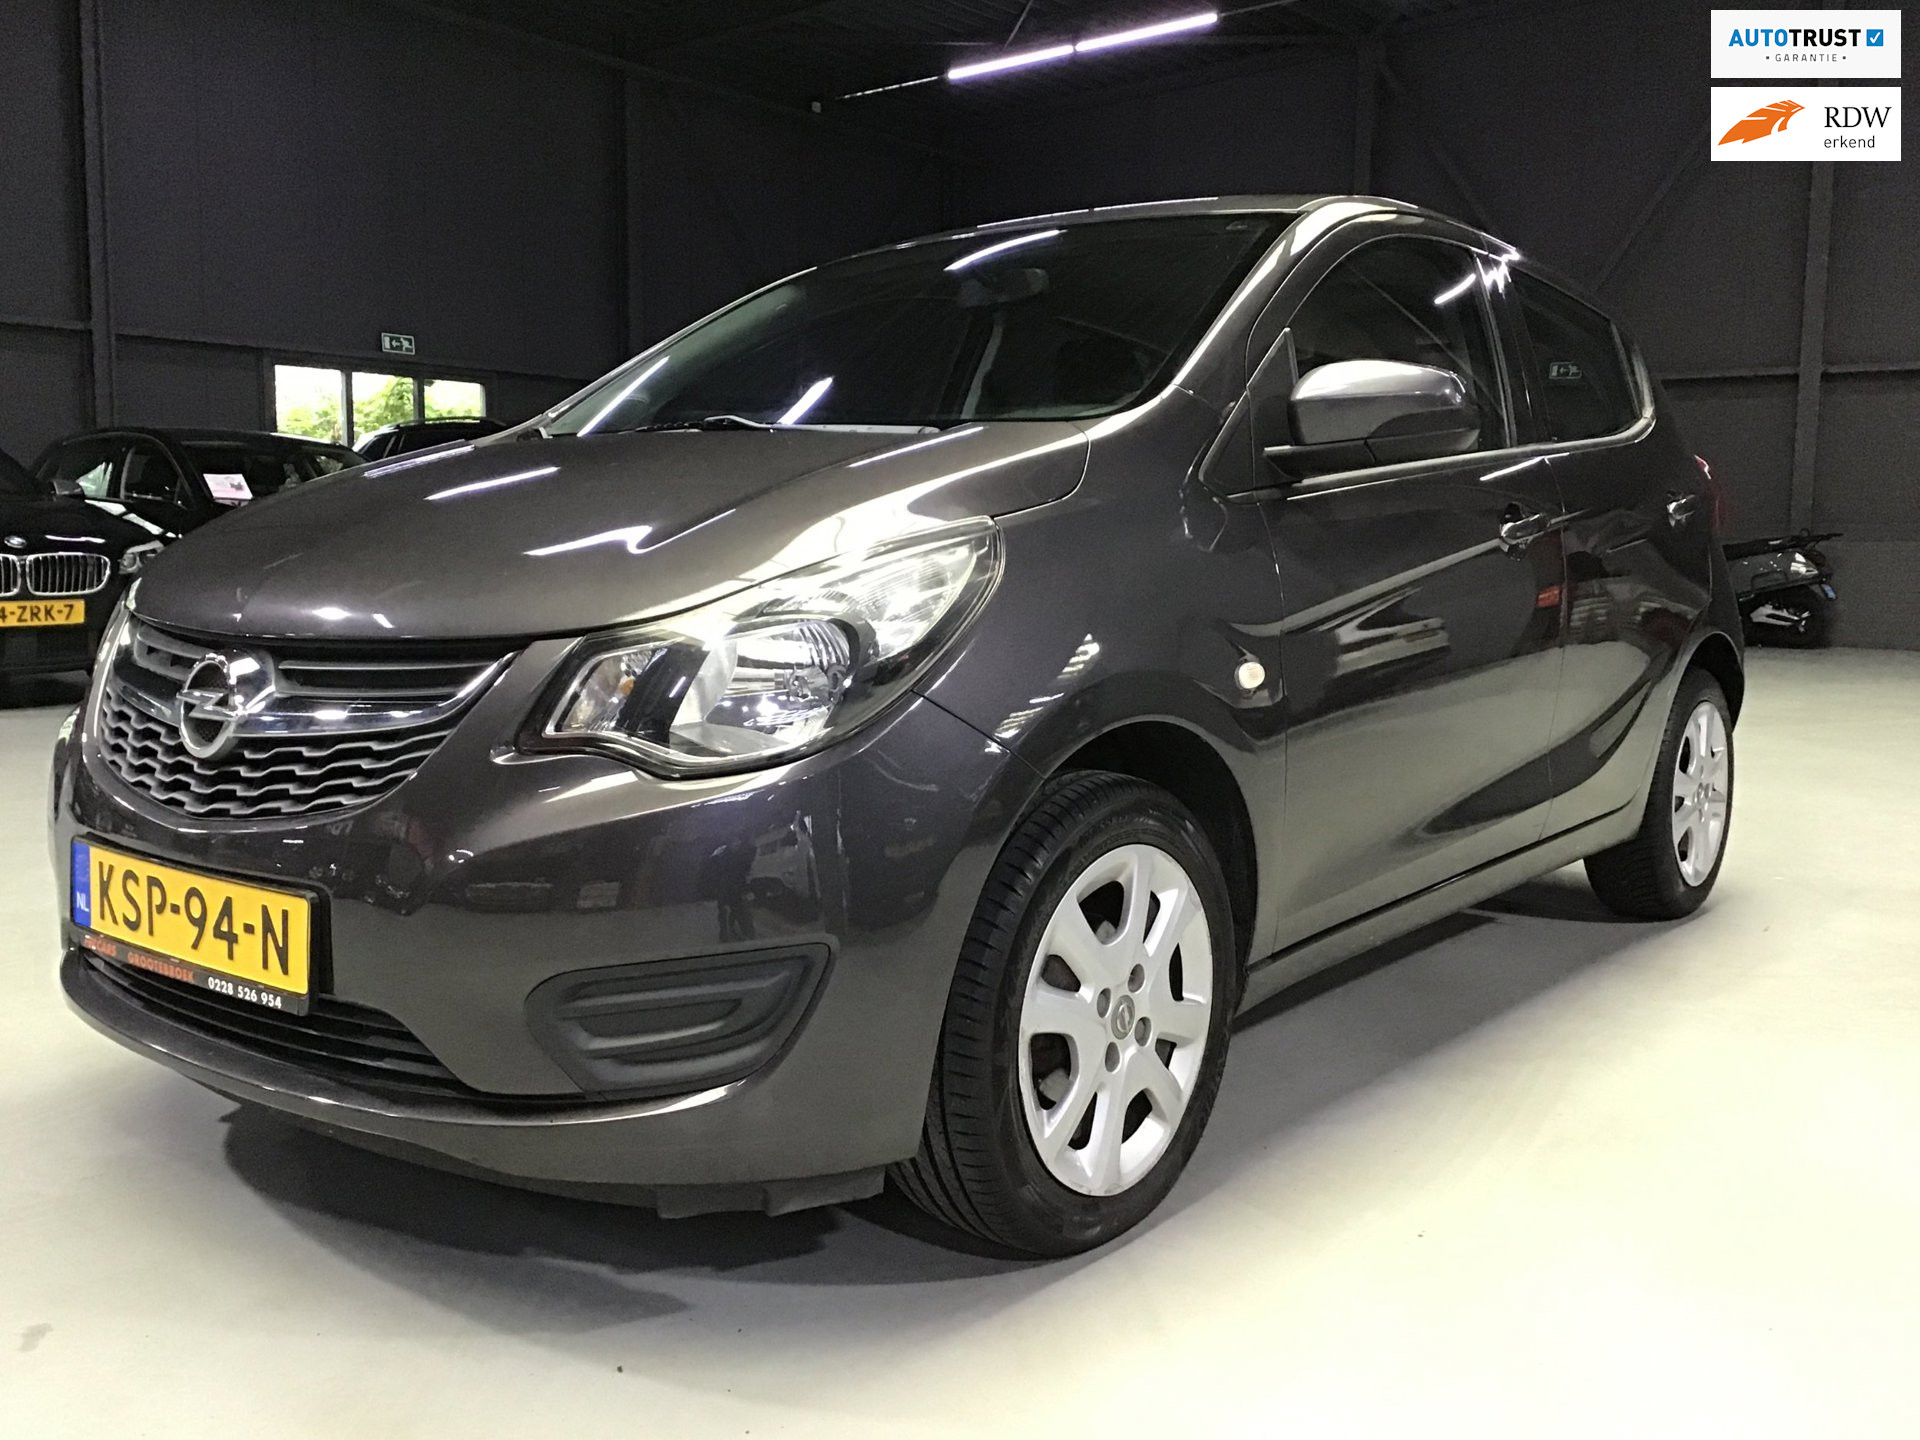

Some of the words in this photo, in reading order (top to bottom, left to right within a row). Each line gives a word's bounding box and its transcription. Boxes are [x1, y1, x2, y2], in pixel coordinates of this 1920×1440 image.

[76, 891, 90, 912] NL
[98, 861, 289, 976] KSP-94-N
[208, 976, 233, 995] 0228
[237, 985, 258, 1002] 526
[261, 992, 282, 1009] 954
